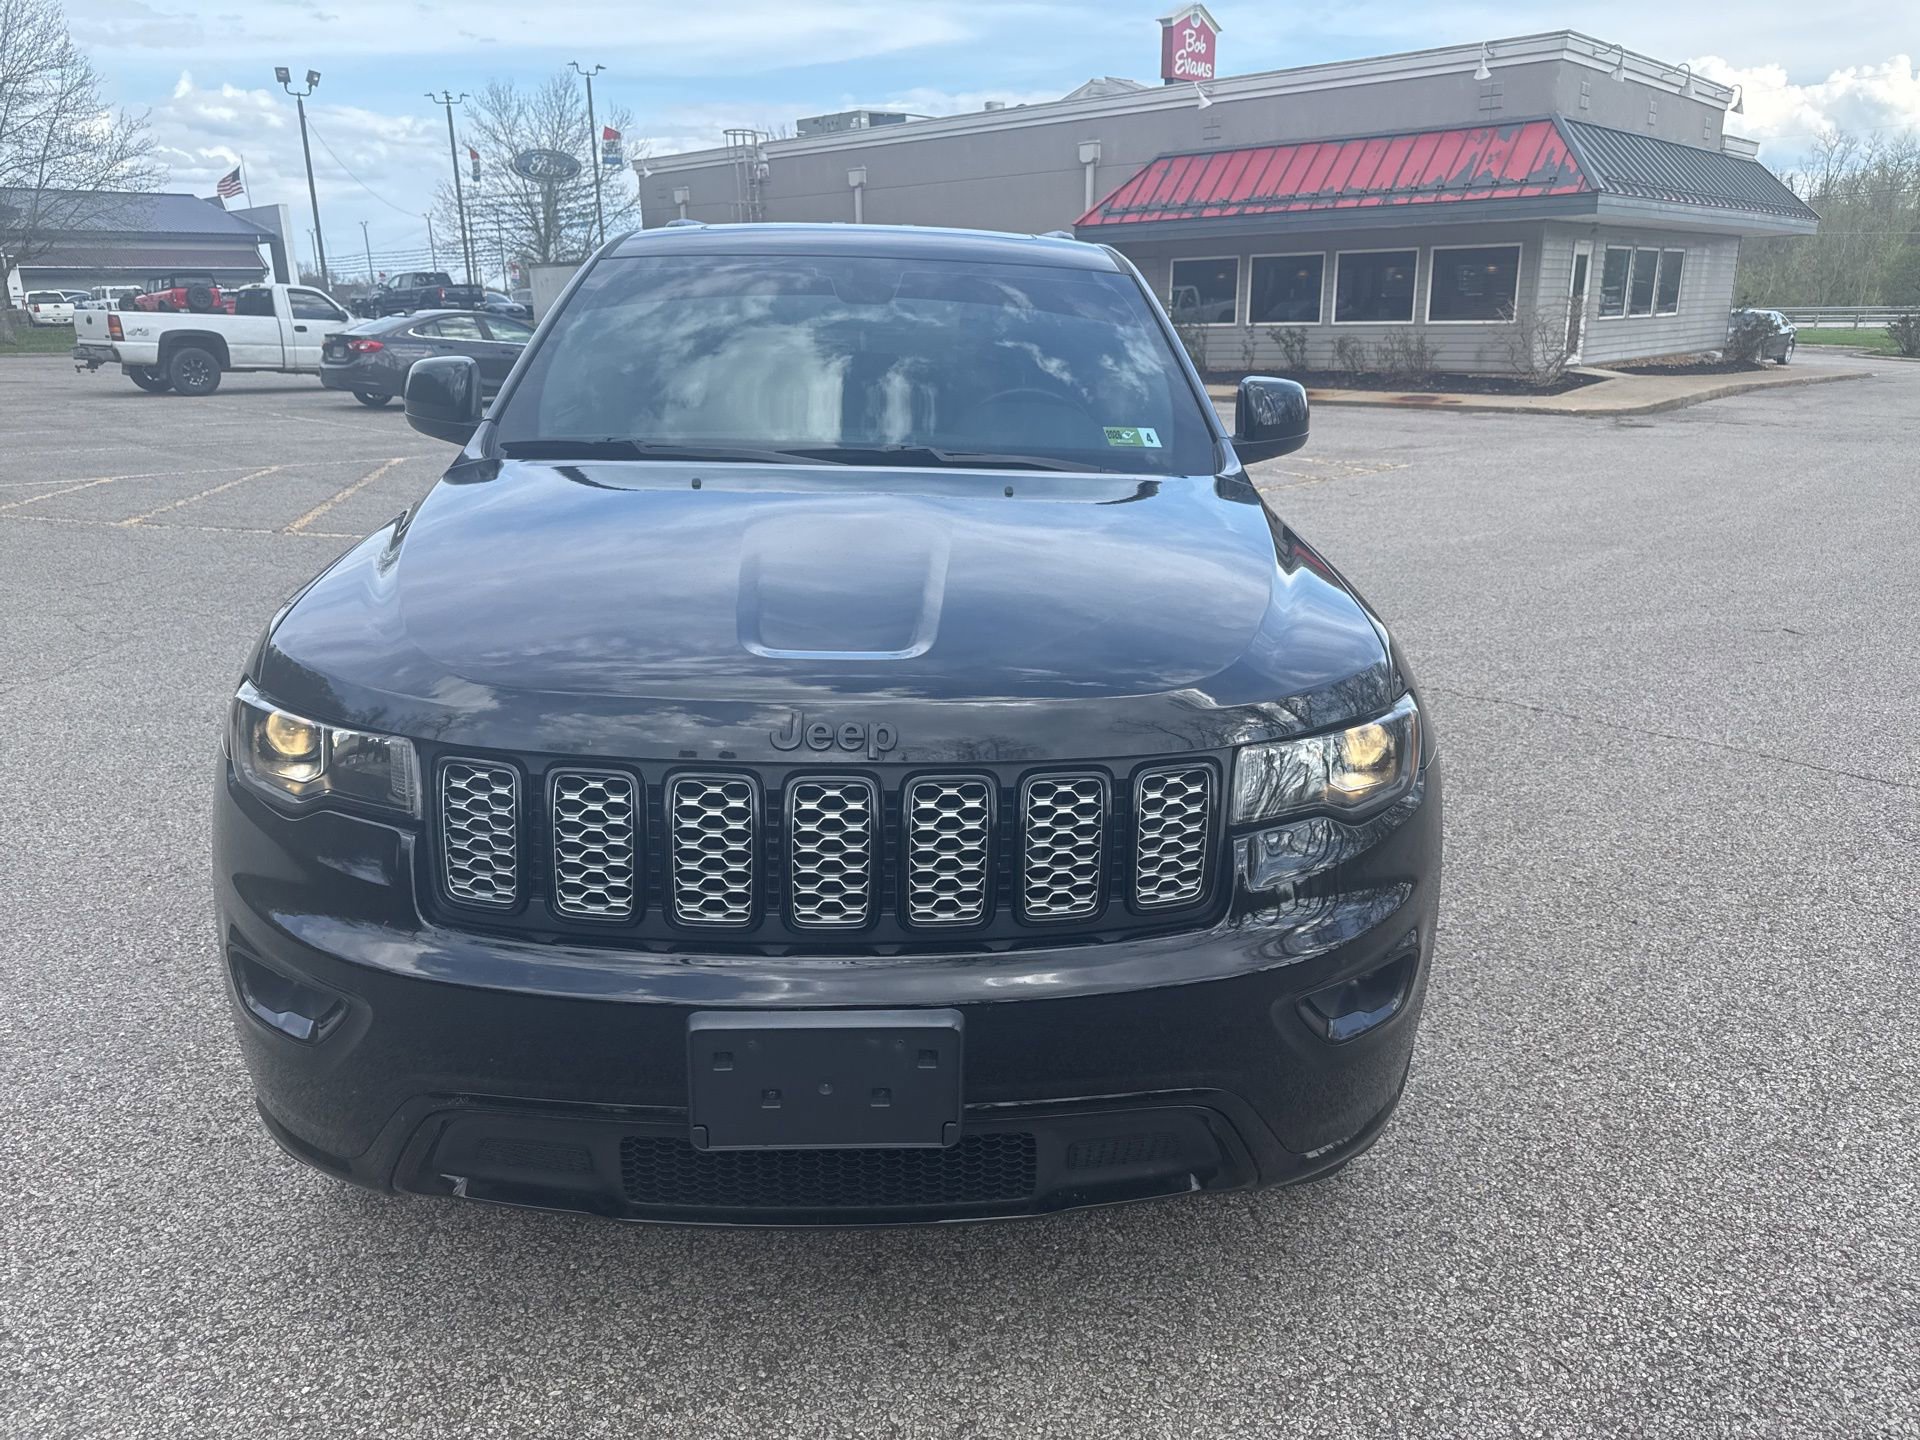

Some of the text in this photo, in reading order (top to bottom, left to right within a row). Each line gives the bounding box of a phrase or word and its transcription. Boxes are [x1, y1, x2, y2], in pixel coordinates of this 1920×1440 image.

[1182, 28, 1207, 54] Bob
[1174, 49, 1212, 78] Evans
[529, 154, 569, 175] Ford
[1146, 432, 1154, 444] 4
[769, 711, 898, 761] Jeep
